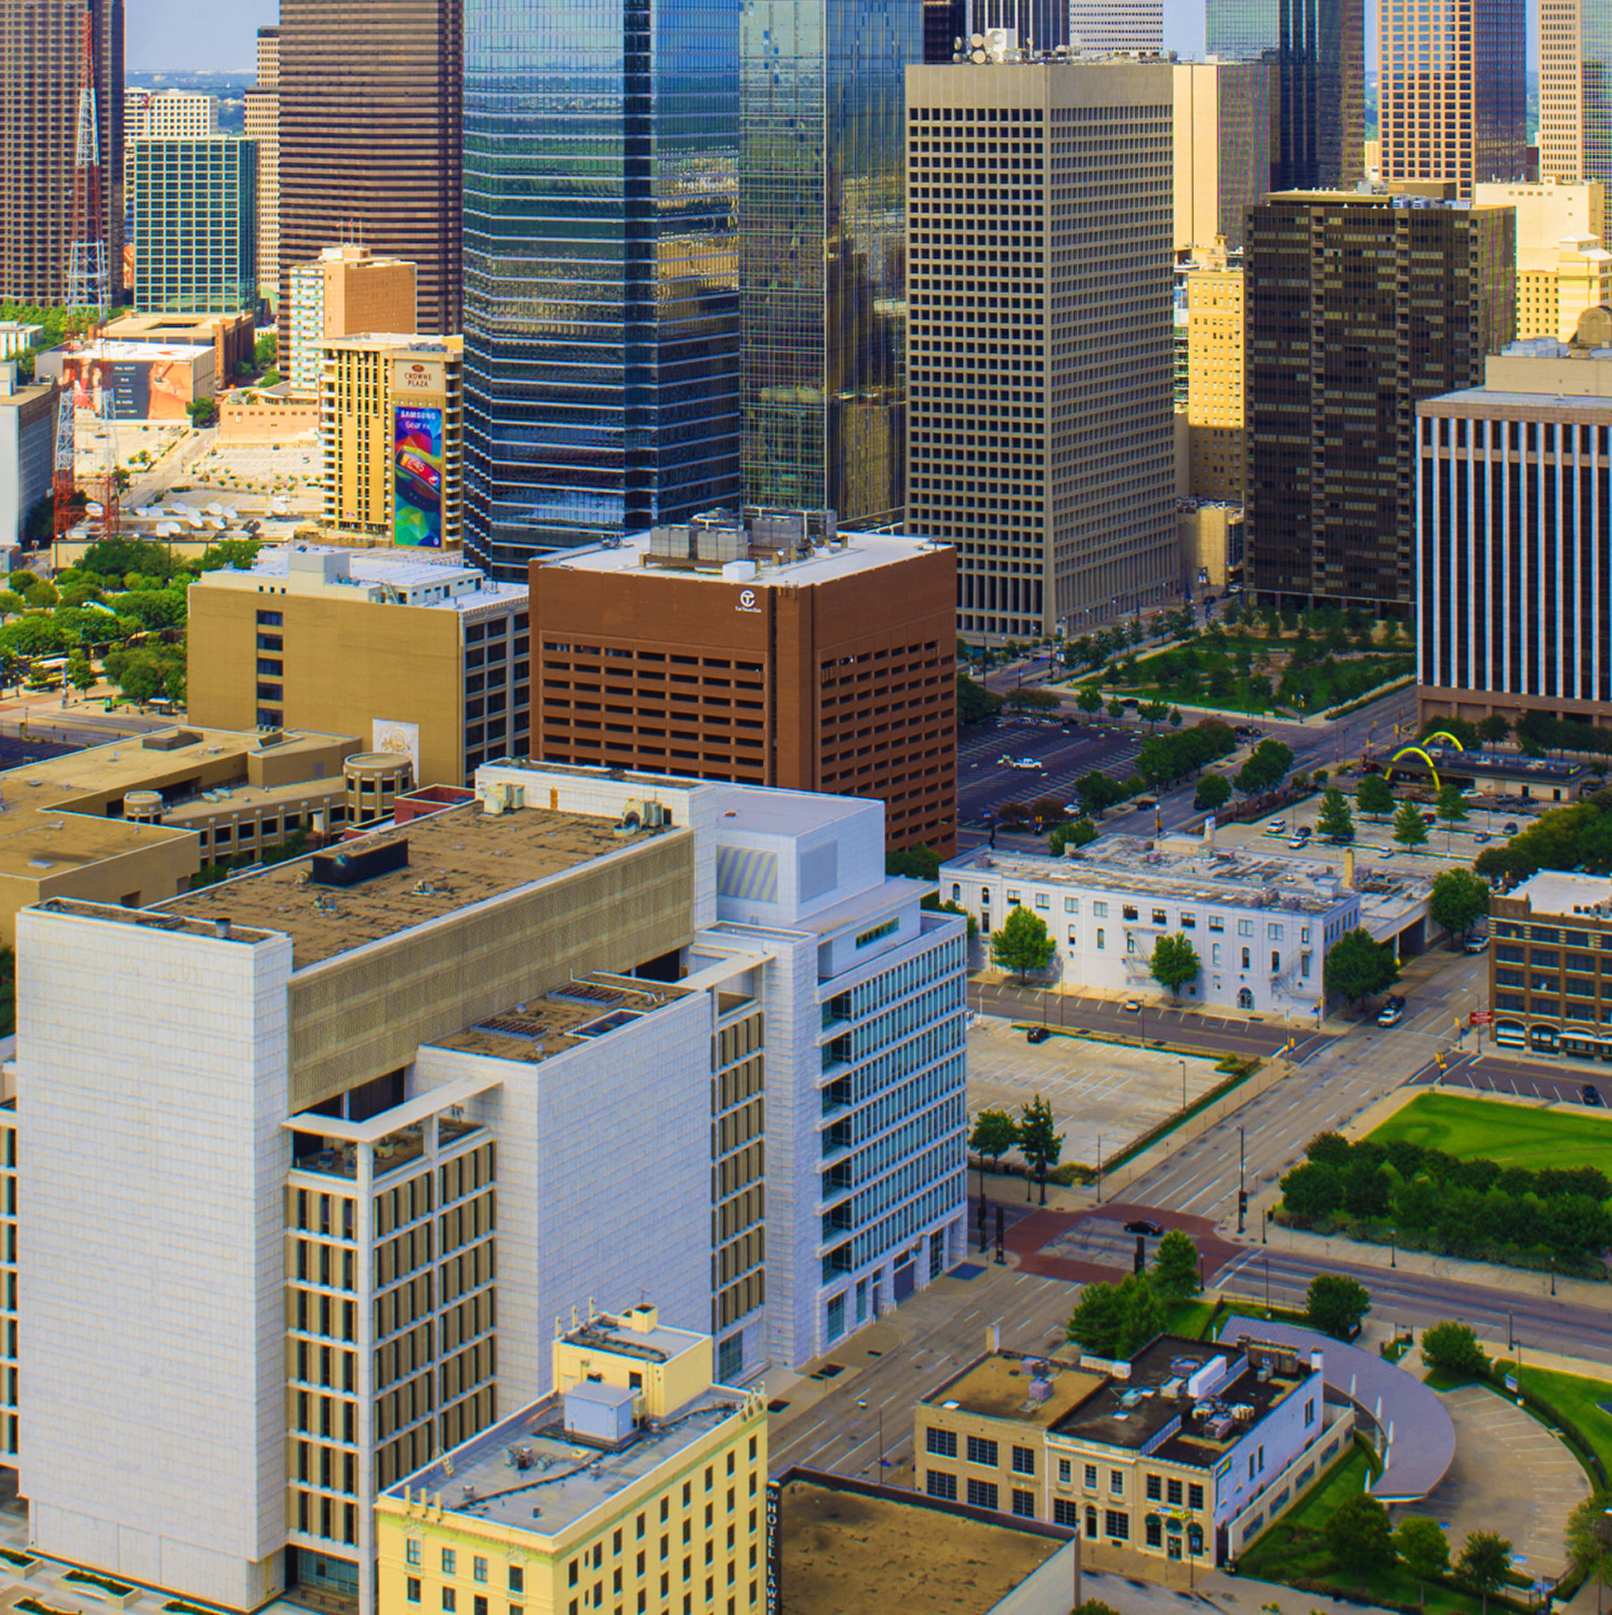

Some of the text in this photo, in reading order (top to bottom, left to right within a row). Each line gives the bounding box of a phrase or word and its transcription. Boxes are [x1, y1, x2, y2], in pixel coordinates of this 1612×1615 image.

[404, 372, 433, 381] CROWNE
[407, 379, 429, 387] PLAZA
[400, 410, 436, 420] SAMSUNG
[405, 421, 421, 429] Gear
[766, 1501, 778, 1559] HOTEL
